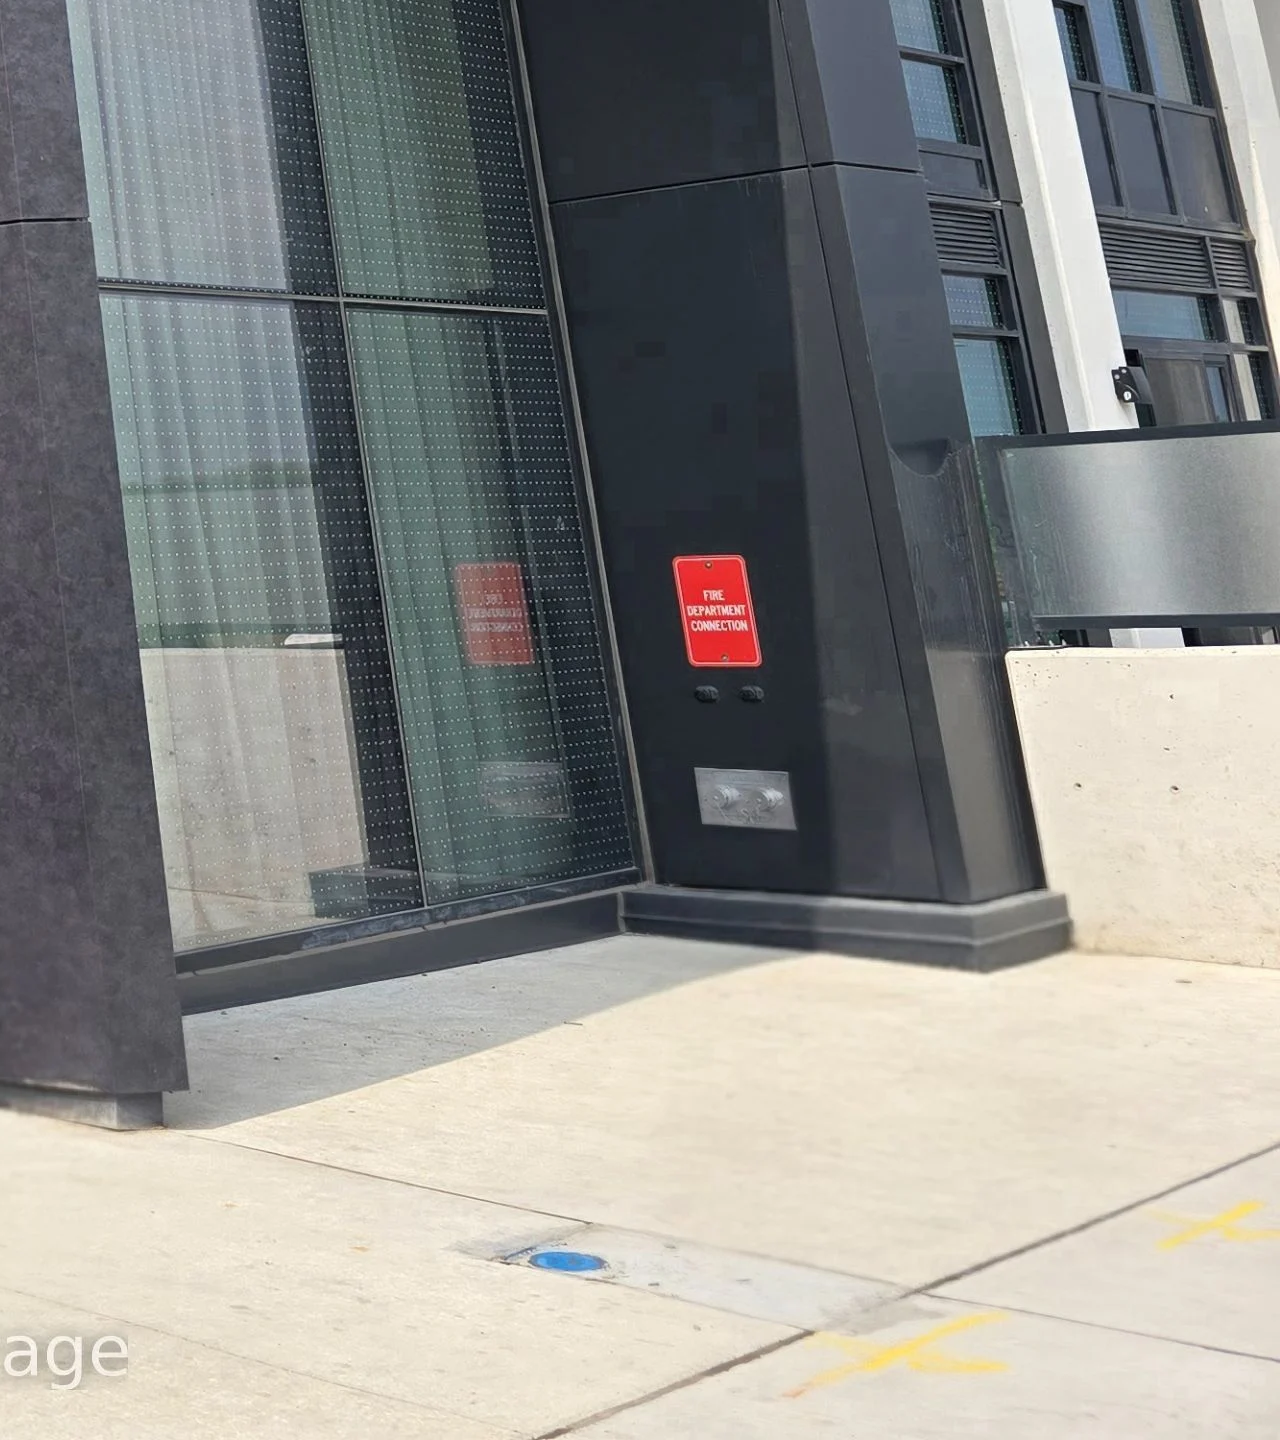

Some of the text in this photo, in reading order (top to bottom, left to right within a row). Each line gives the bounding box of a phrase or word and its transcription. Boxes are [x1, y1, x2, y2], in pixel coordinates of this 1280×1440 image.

[703, 589, 725, 601] FIRE
[686, 604, 746, 617] DEPARTMENT
[691, 620, 749, 632] CONNECTION
